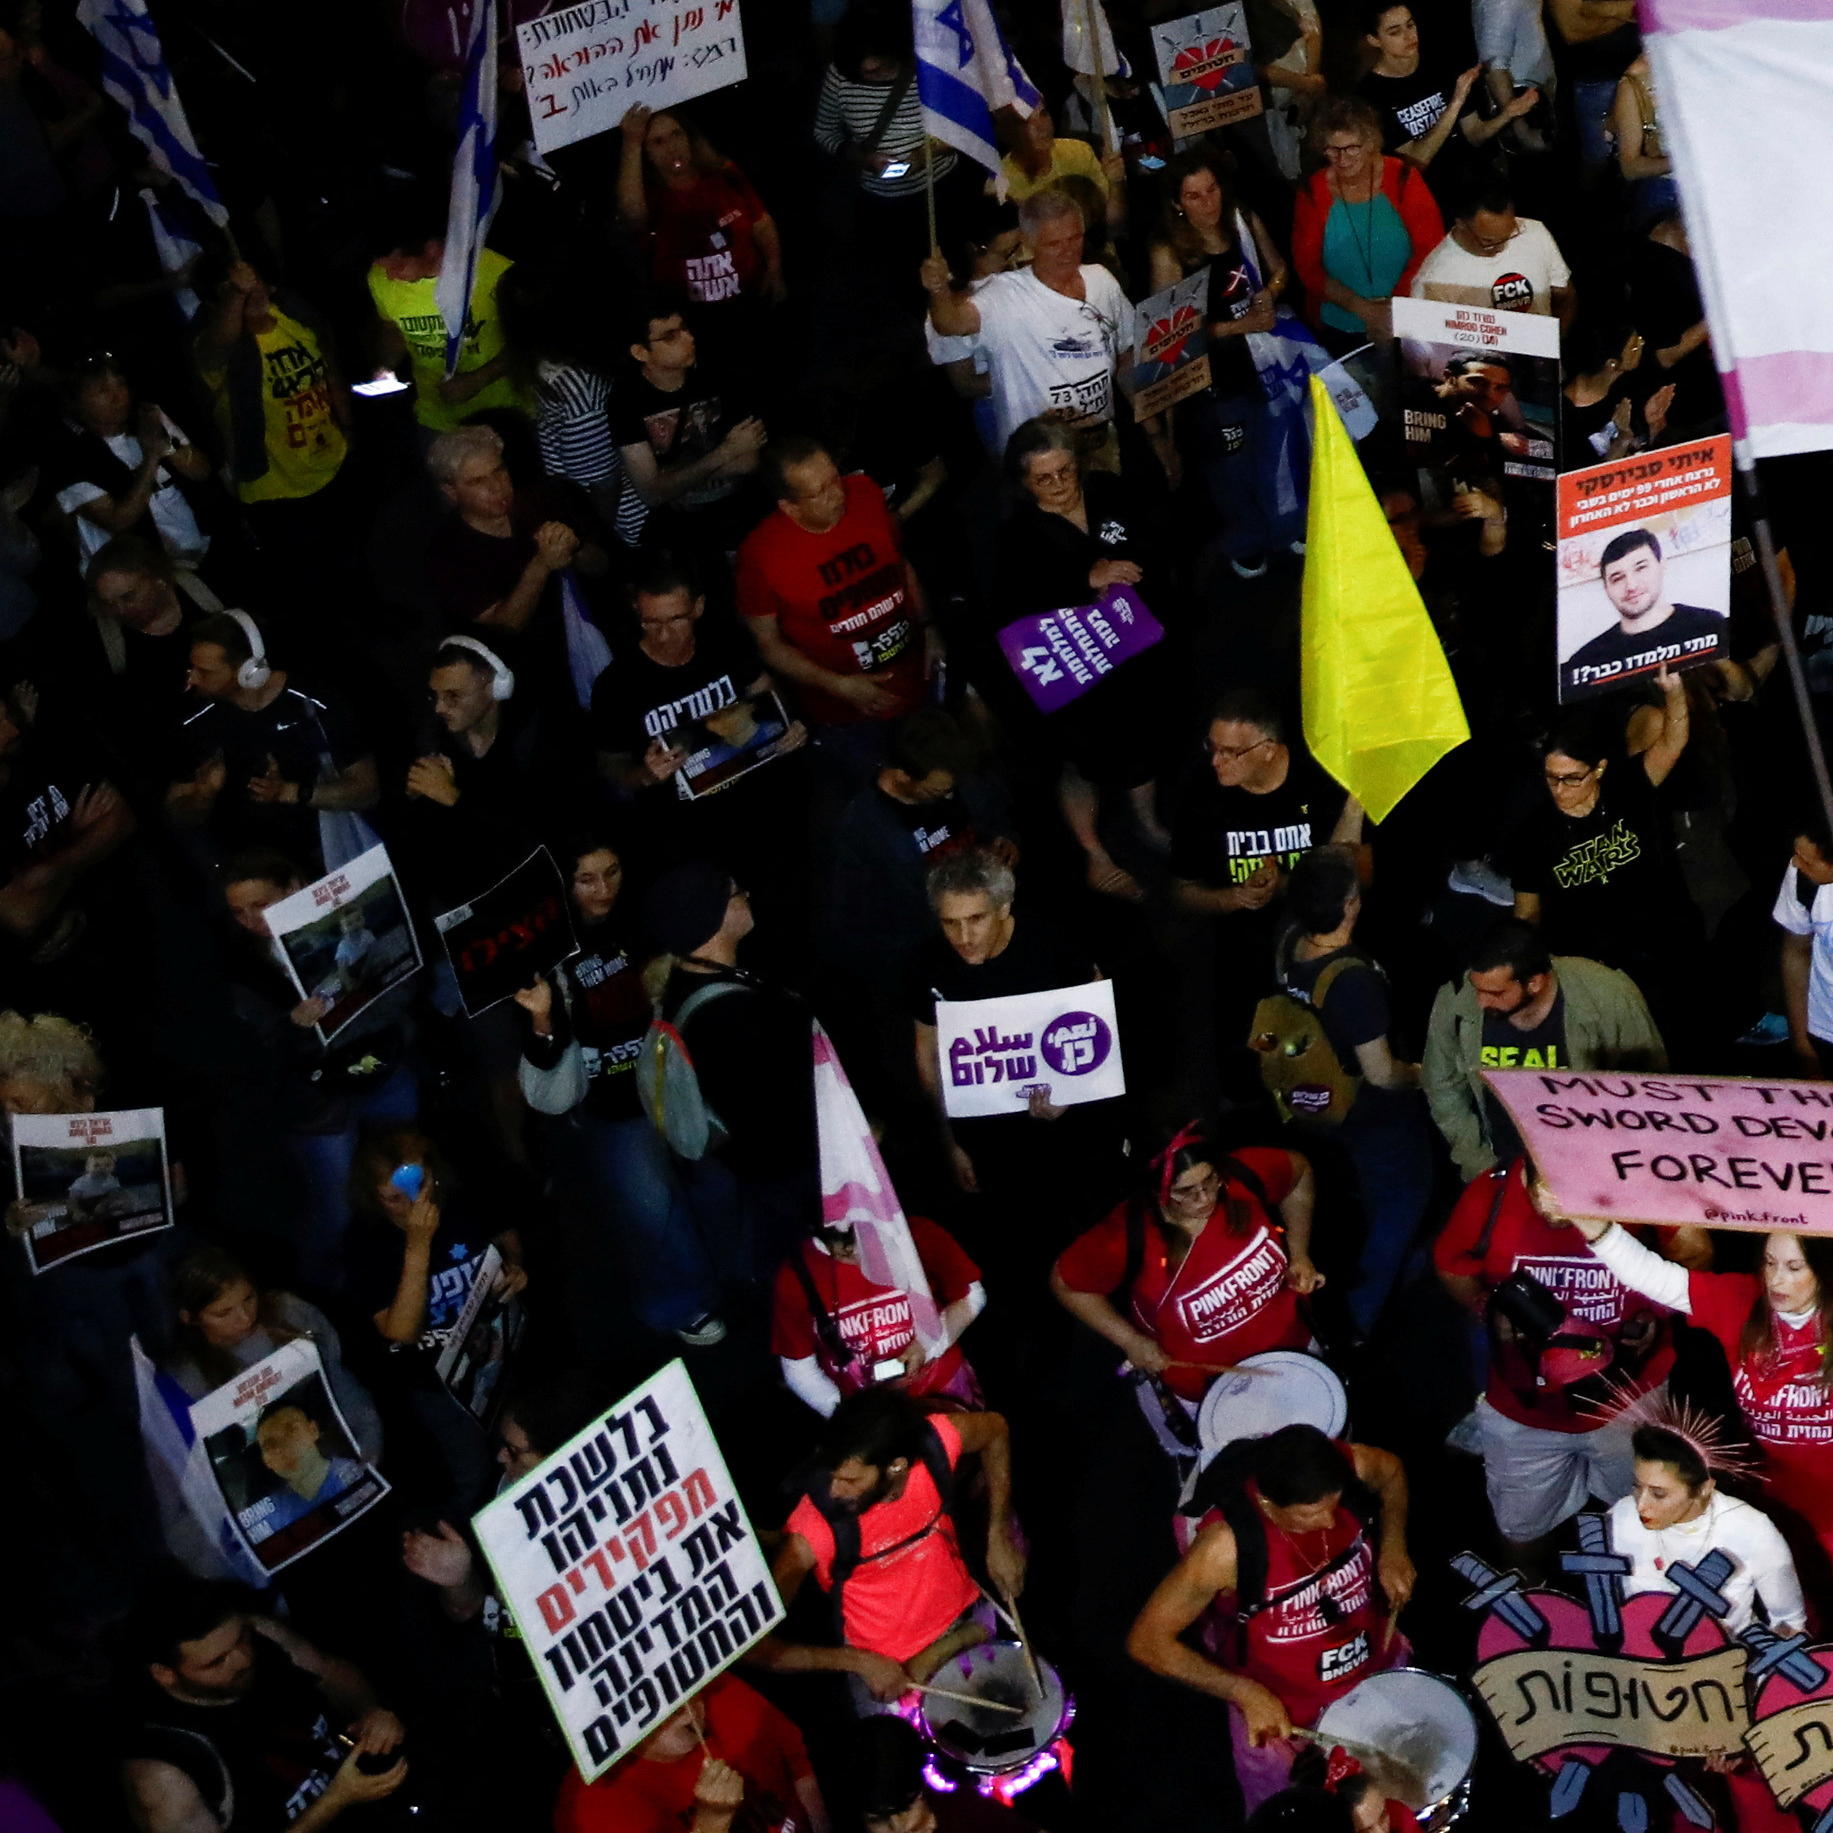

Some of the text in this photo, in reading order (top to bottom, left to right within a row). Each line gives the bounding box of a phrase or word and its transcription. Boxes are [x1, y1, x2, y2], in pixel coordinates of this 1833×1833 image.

[1178, 54, 1235, 78] חטופים
[685, 252, 735, 279] אתה
[1494, 278, 1531, 297] FCK
[1403, 407, 1447, 430] BRING
[1403, 425, 1432, 444] HIM
[1576, 448, 1715, 496] איתי סבירסקי
[1576, 467, 1716, 510] נרצח אחרי 99 ימים בשבי
[1569, 478, 1722, 529] לא הראשון וכבר לא האחרון
[1019, 645, 1064, 687] לא
[1572, 632, 1719, 688] מתי תלמדו כבר?!
[1226, 822, 1313, 857] אתם בבית
[1553, 833, 1642, 888] WARS
[949, 1053, 1037, 1087] שלום
[1480, 1044, 1569, 1070] SEAL
[1537, 1074, 1725, 1105] MUST
[1534, 1101, 1720, 1136] SWORD
[1193, 1246, 1278, 1322] PINKFRONT
[514, 1395, 672, 1541] בלשכת
[540, 1443, 680, 1573] נתניהו
[681, 1500, 749, 1558] את
[534, 1466, 719, 1637] מפקירים
[540, 1567, 685, 1694] ביטחון
[588, 1562, 740, 1712] המדינה
[1322, 1629, 1367, 1669] FCK
[581, 1580, 775, 1767] והחטופים
[1515, 1668, 1737, 1724] חטופות
